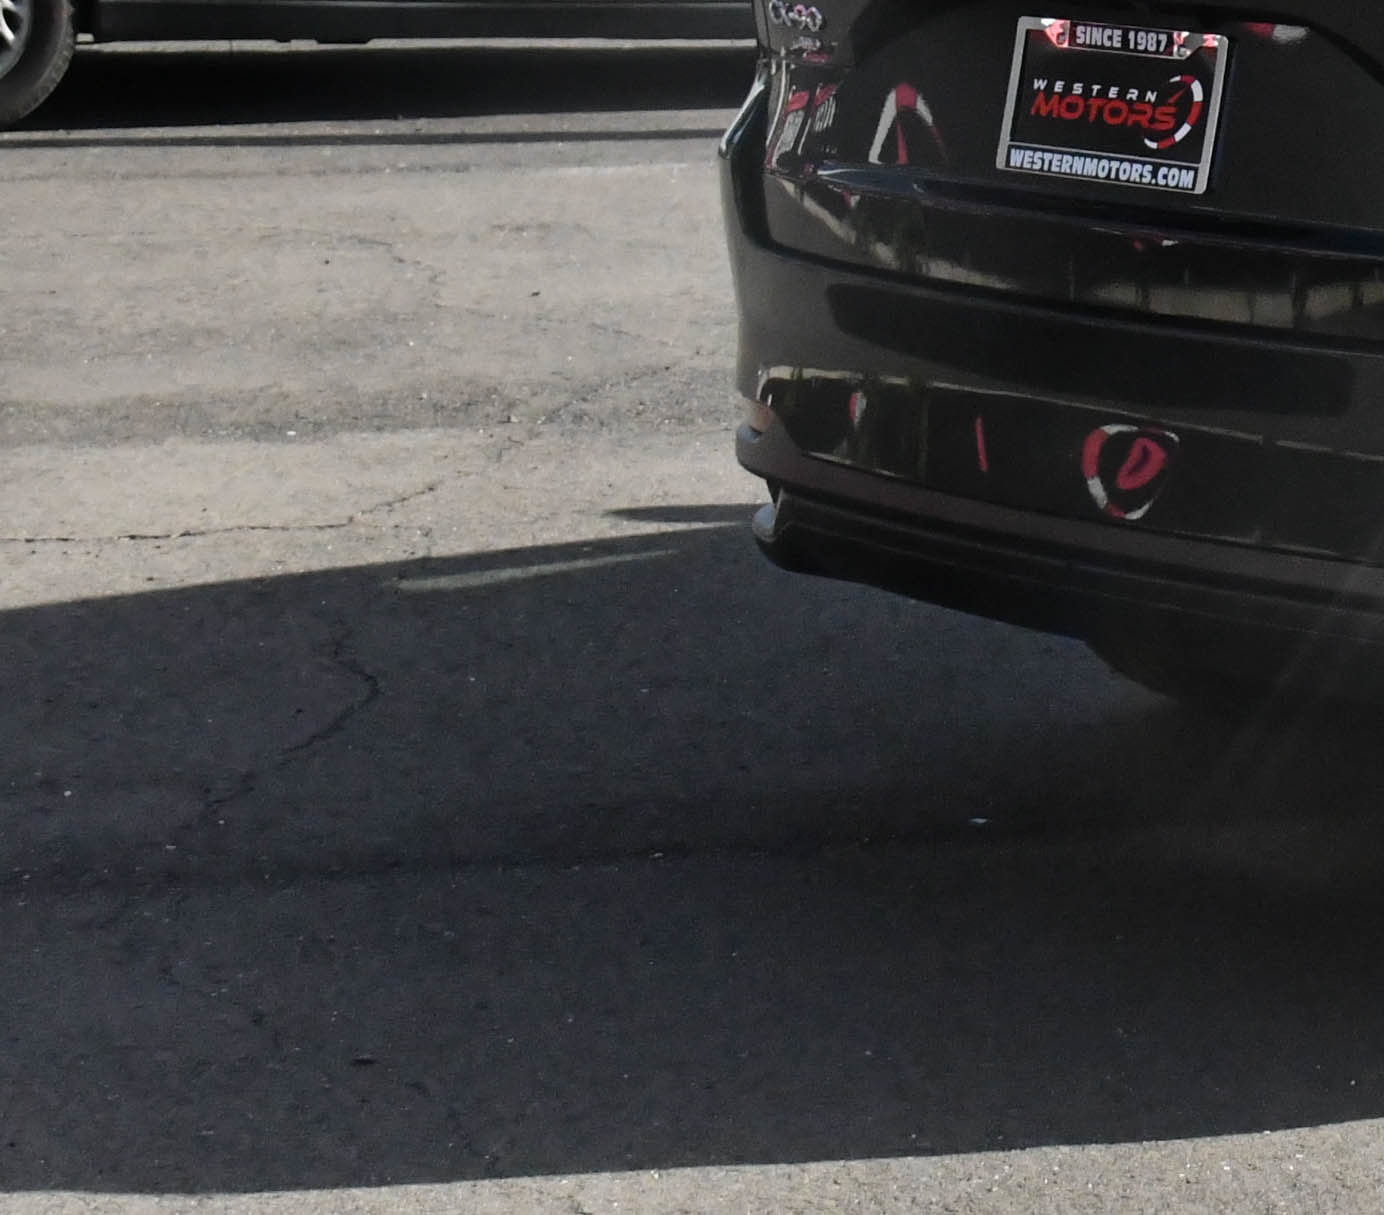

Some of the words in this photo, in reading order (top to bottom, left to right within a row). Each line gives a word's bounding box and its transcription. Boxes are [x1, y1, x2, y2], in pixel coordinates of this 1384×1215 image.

[1075, 25, 1122, 50] SINCE
[1127, 30, 1167, 53] 1987
[1033, 78, 1158, 103] WESTERN
[1030, 91, 1177, 132] MOTORS
[1009, 147, 1195, 190] WESTERNMOTORS.COM
